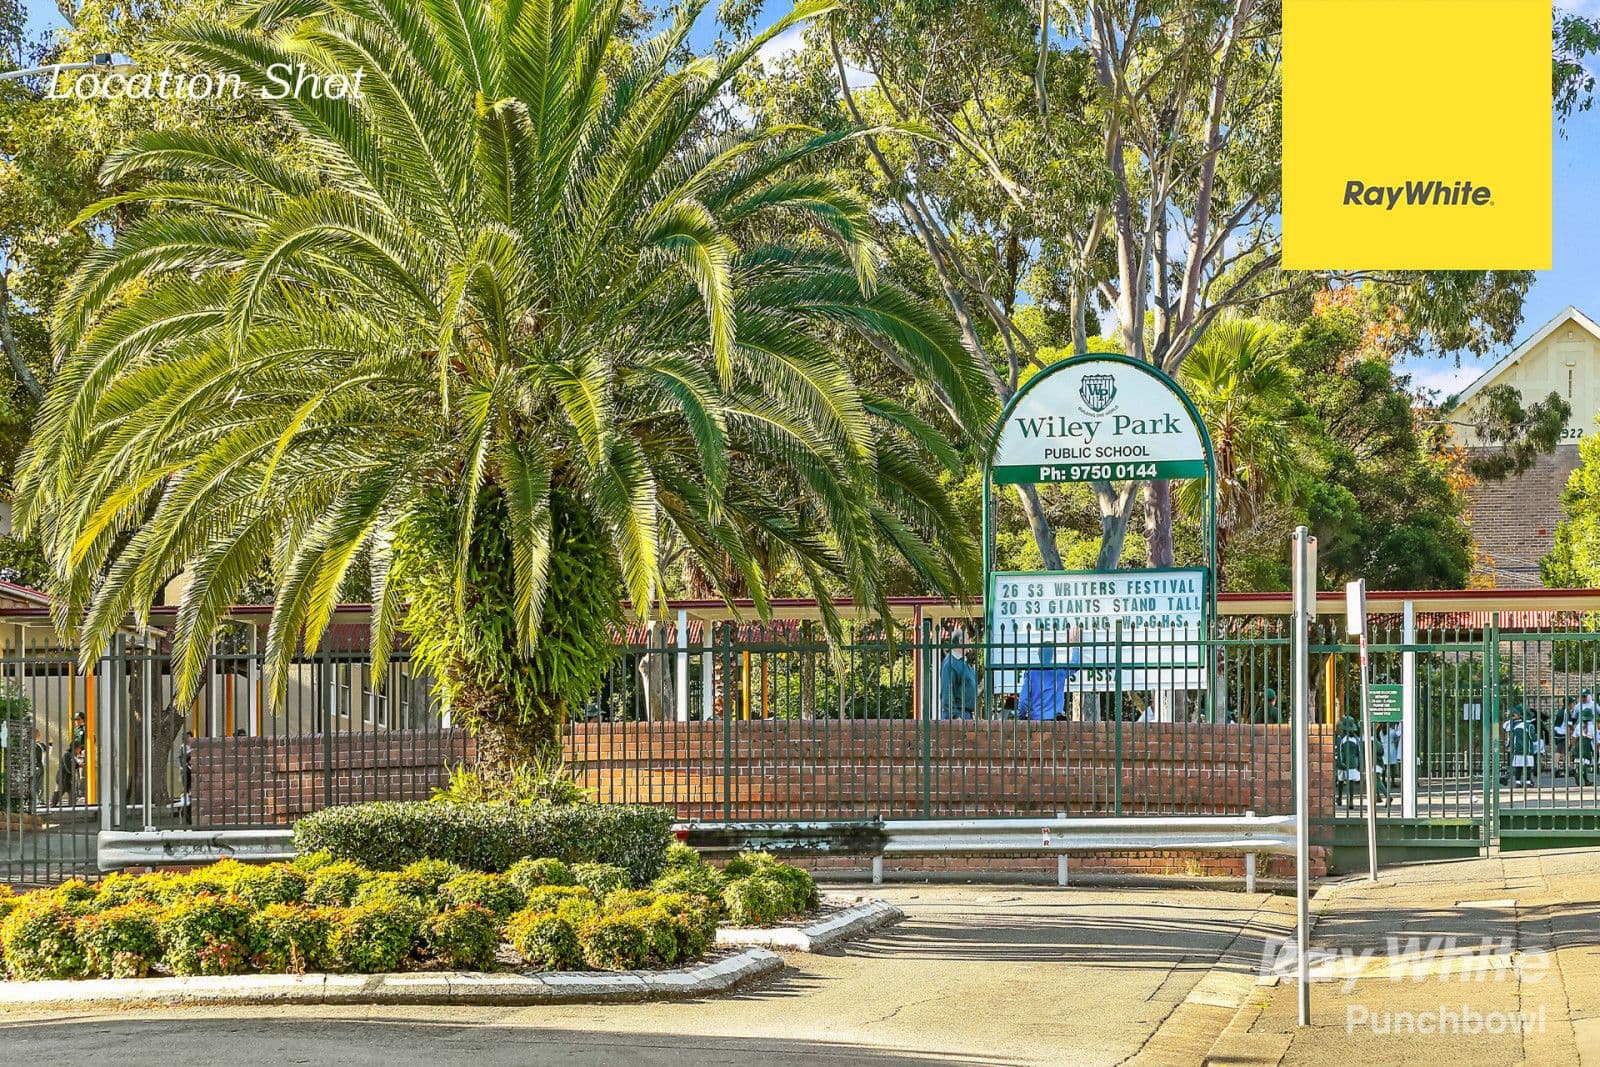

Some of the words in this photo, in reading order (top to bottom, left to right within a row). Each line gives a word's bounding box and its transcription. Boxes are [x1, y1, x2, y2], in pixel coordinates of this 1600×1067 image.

[1015, 415, 1102, 445] Wiley
[1112, 412, 1183, 436] Park
[1044, 447, 1092, 460] PUBLIC
[1095, 445, 1150, 458] SCHOOL
[1040, 465, 1066, 481] Ph:
[1070, 464, 1112, 480] 9750
[1116, 463, 1158, 479] 0144
[1002, 583, 1019, 599] 26
[1027, 583, 1044, 598] S3
[1053, 581, 1117, 597] WRITERS
[1126, 578, 1196, 595] FESTIVAL
[1000, 600, 1018, 616] 30
[1025, 600, 1041, 615] S3
[1048, 599, 1101, 614] GIANTS
[1113, 597, 1157, 613] STAND
[1167, 596, 1201, 611] TALL
